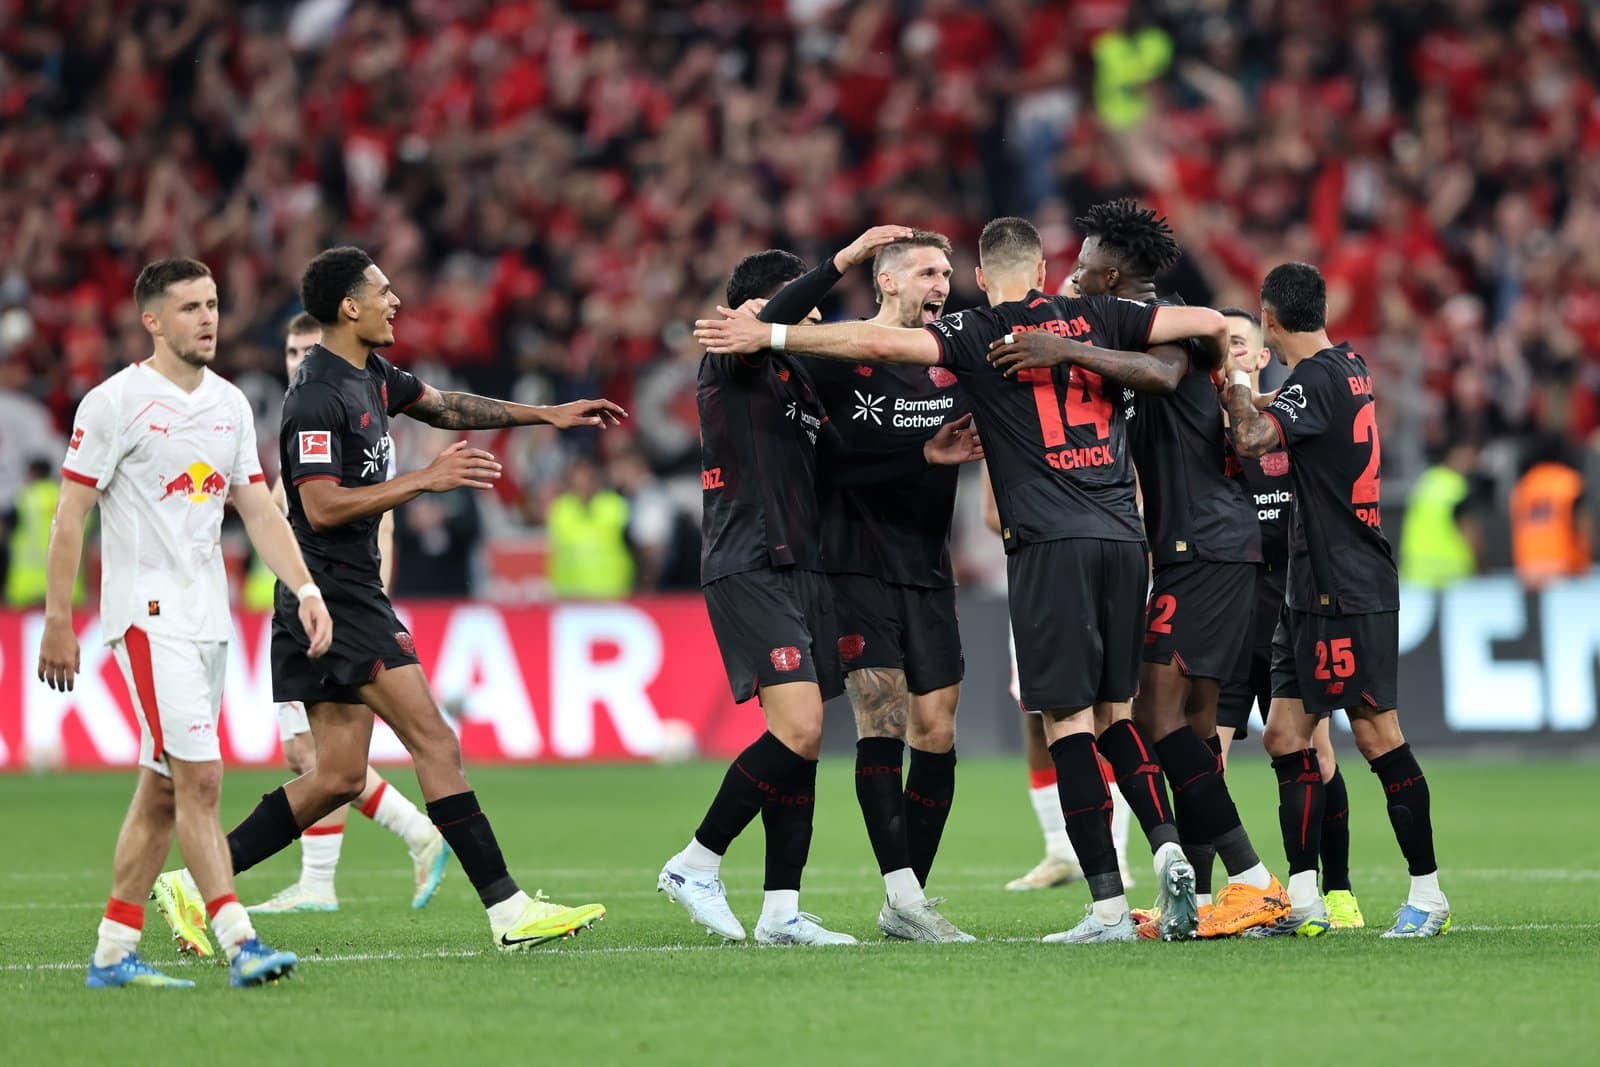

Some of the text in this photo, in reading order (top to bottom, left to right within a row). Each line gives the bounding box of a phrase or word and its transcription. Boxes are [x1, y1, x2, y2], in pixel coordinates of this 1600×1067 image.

[894, 395, 954, 411] Barmenia
[1017, 340, 1113, 449] 14
[892, 413, 945, 428] Gothaer
[1045, 444, 1115, 470] SCHICK
[1146, 594, 1177, 634] 2
[1314, 637, 1356, 680] 25
